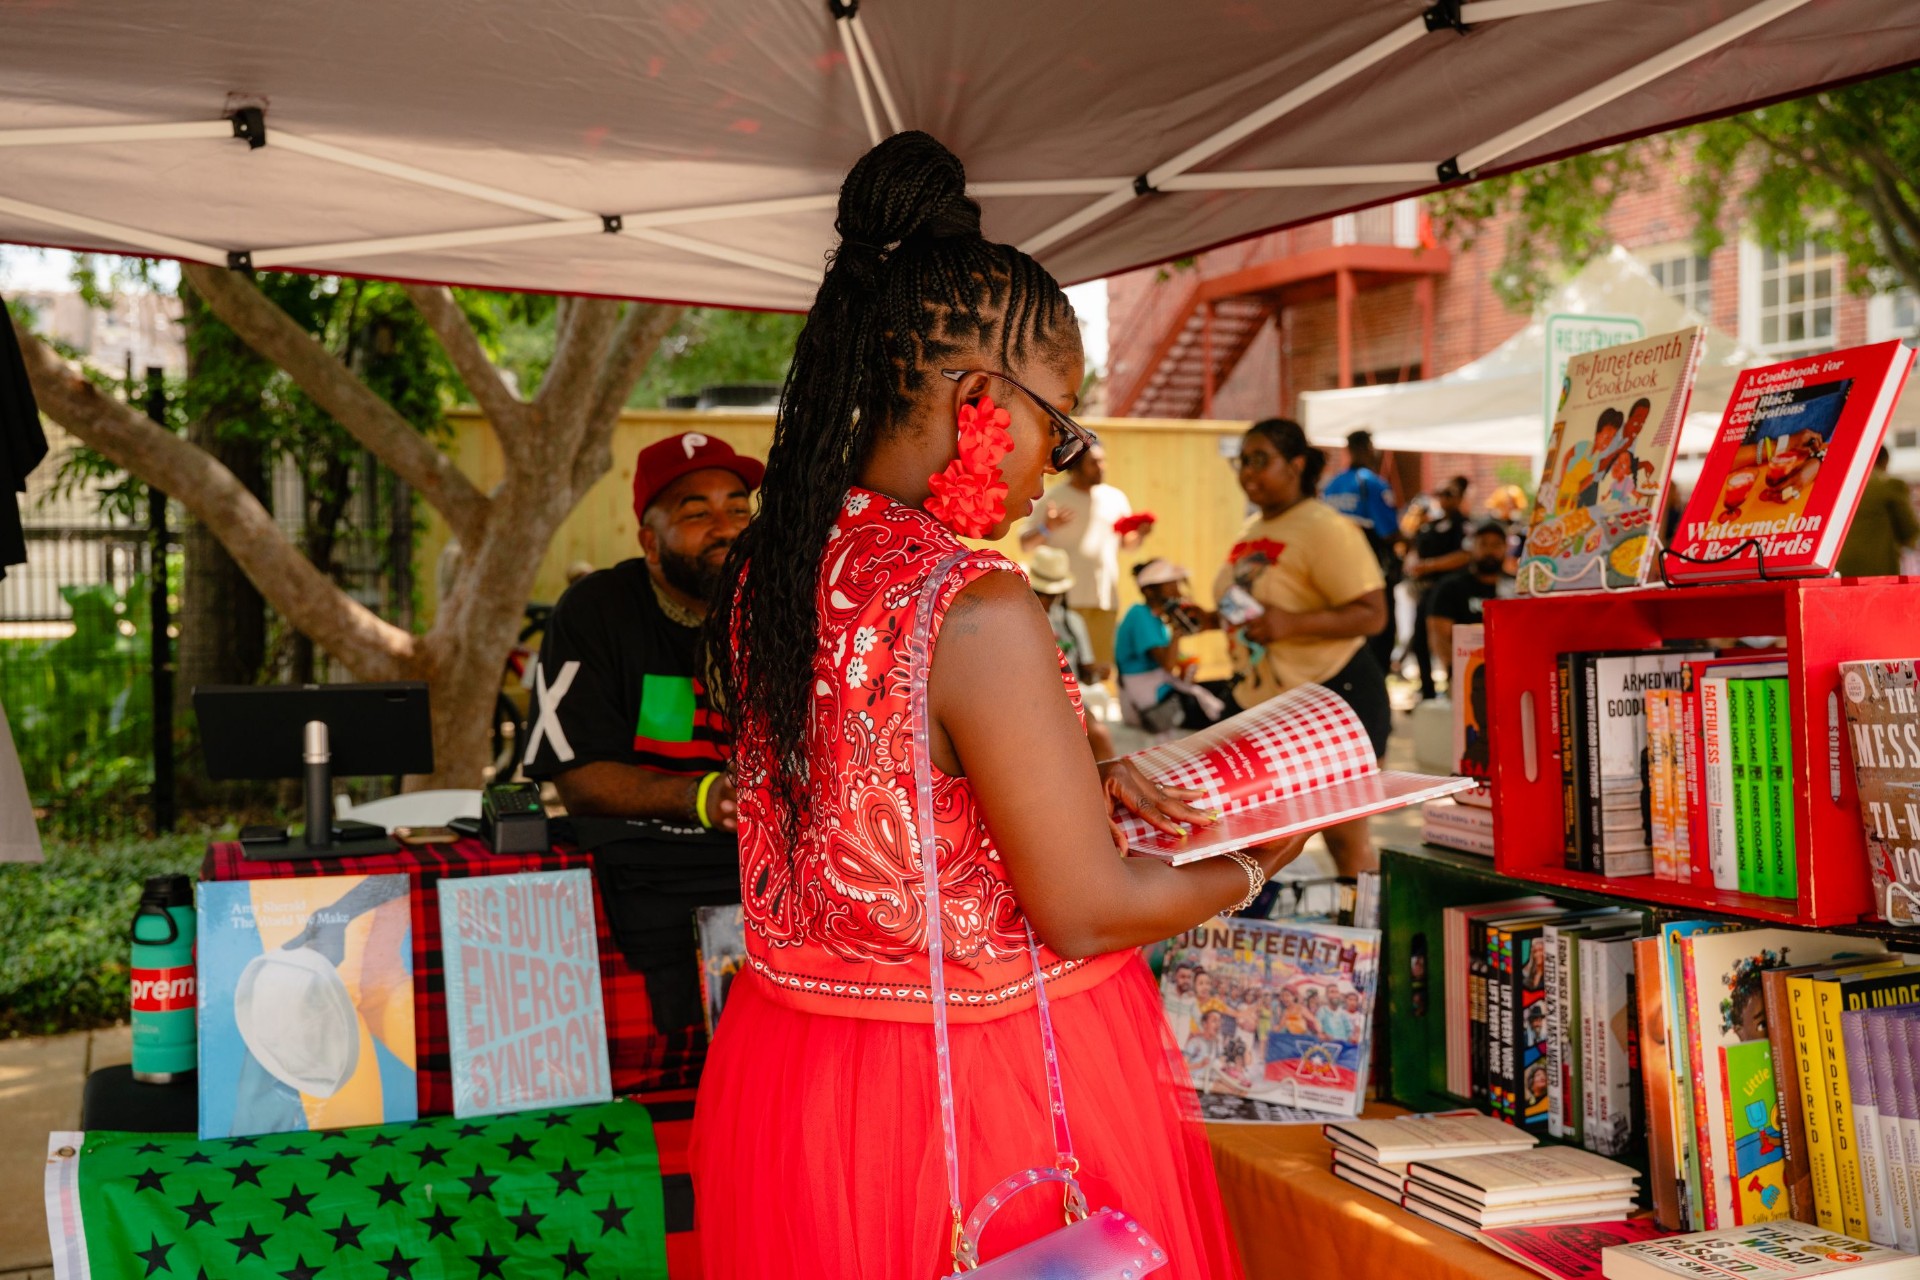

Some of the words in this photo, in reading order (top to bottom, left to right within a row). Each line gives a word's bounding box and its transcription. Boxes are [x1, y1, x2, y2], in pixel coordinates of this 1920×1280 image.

[1586, 335, 1682, 386] Juneteenth
[1744, 375, 1755, 387] A
[1757, 363, 1819, 386] Cookbook
[1822, 360, 1844, 373] for
[1587, 367, 1659, 400] Cookbook
[1728, 404, 1806, 425] Celebrations
[1734, 397, 1760, 412] and
[1760, 392, 1795, 408] Black
[1686, 512, 1822, 542] Watermelon
[1679, 542, 1700, 564] &
[1703, 537, 1744, 561] Red
[1748, 534, 1814, 559] Birds
[1585, 667, 1596, 698] ARMED
[1622, 672, 1661, 692] ARMED
[1586, 698, 1596, 720] WITH
[1608, 698, 1640, 718] GOOD
[1728, 686, 1738, 724] MODEL
[1746, 686, 1756, 726] MODEL
[1768, 684, 1777, 725] MODEL
[1885, 688, 1918, 714] THE
[1588, 721, 1598, 746] GOOD
[1704, 685, 1720, 764] FACTFULNESS
[1731, 726, 1740, 761] HOME
[1748, 728, 1758, 763] HOME
[1770, 727, 1779, 763] HOME
[1830, 726, 1840, 771] SOUTH
[1734, 783, 1743, 816] RIVERS
[1752, 785, 1760, 818] RIVERS
[1773, 784, 1782, 818] RIVERS
[1736, 818, 1746, 871] SOLOMON
[1754, 820, 1764, 874] SOLOMON
[1775, 820, 1784, 876] SOLOMON
[230, 903, 260, 918] Amy
[230, 916, 257, 930] The
[260, 914, 294, 927] World
[296, 914, 314, 926] We
[317, 912, 350, 925] Make
[456, 886, 502, 944] BIG
[505, 880, 595, 962] BUTCH
[1180, 926, 1358, 973] JUNETEENTH
[1558, 938, 1567, 966] FROM
[1545, 953, 1556, 983] AFTER
[1560, 969, 1568, 1000] THESE
[460, 944, 595, 1050] ENERGY
[1488, 978, 1500, 1002] LIFT
[1500, 984, 1512, 1008] LIFT
[1546, 985, 1557, 1016] BLACK
[1488, 1004, 1500, 1040] EVERY
[1501, 1010, 1513, 1046] EVERY
[1548, 1018, 1558, 1045] LIVES
[470, 1009, 601, 1109] SYNERGY
[1490, 1041, 1500, 1074] VOICE
[1502, 1046, 1514, 1080] VOICE
[1548, 1047, 1560, 1088] MATTER
[1599, 1060, 1607, 1085] PIECE
[1793, 988, 1819, 1144] PLUNDERED
[1820, 992, 1848, 1150] PLUNDERED
[1742, 1067, 1770, 1096] Little
[1778, 1092, 1787, 1119] BILLIE
[1782, 1120, 1792, 1162] HOLIDAY
[1858, 1123, 1866, 1150] OBAMA
[1863, 1114, 1873, 1150] MICHELLE
[1886, 1134, 1894, 1161] OBAMA
[1890, 1126, 1901, 1160] MICHELLE
[1868, 1156, 1882, 1217] OVERCOMING
[1896, 1167, 1912, 1228] OVERCOMING
[1696, 1238, 1736, 1250] IS
[1737, 1238, 1823, 1266] WORD
[1746, 1226, 1802, 1245] THE
[1810, 1234, 1883, 1254] HOW
[1628, 1243, 1680, 1265] CLINT
[1678, 1261, 1736, 1280] SMIT
[1655, 1239, 1760, 1273] PASSED
